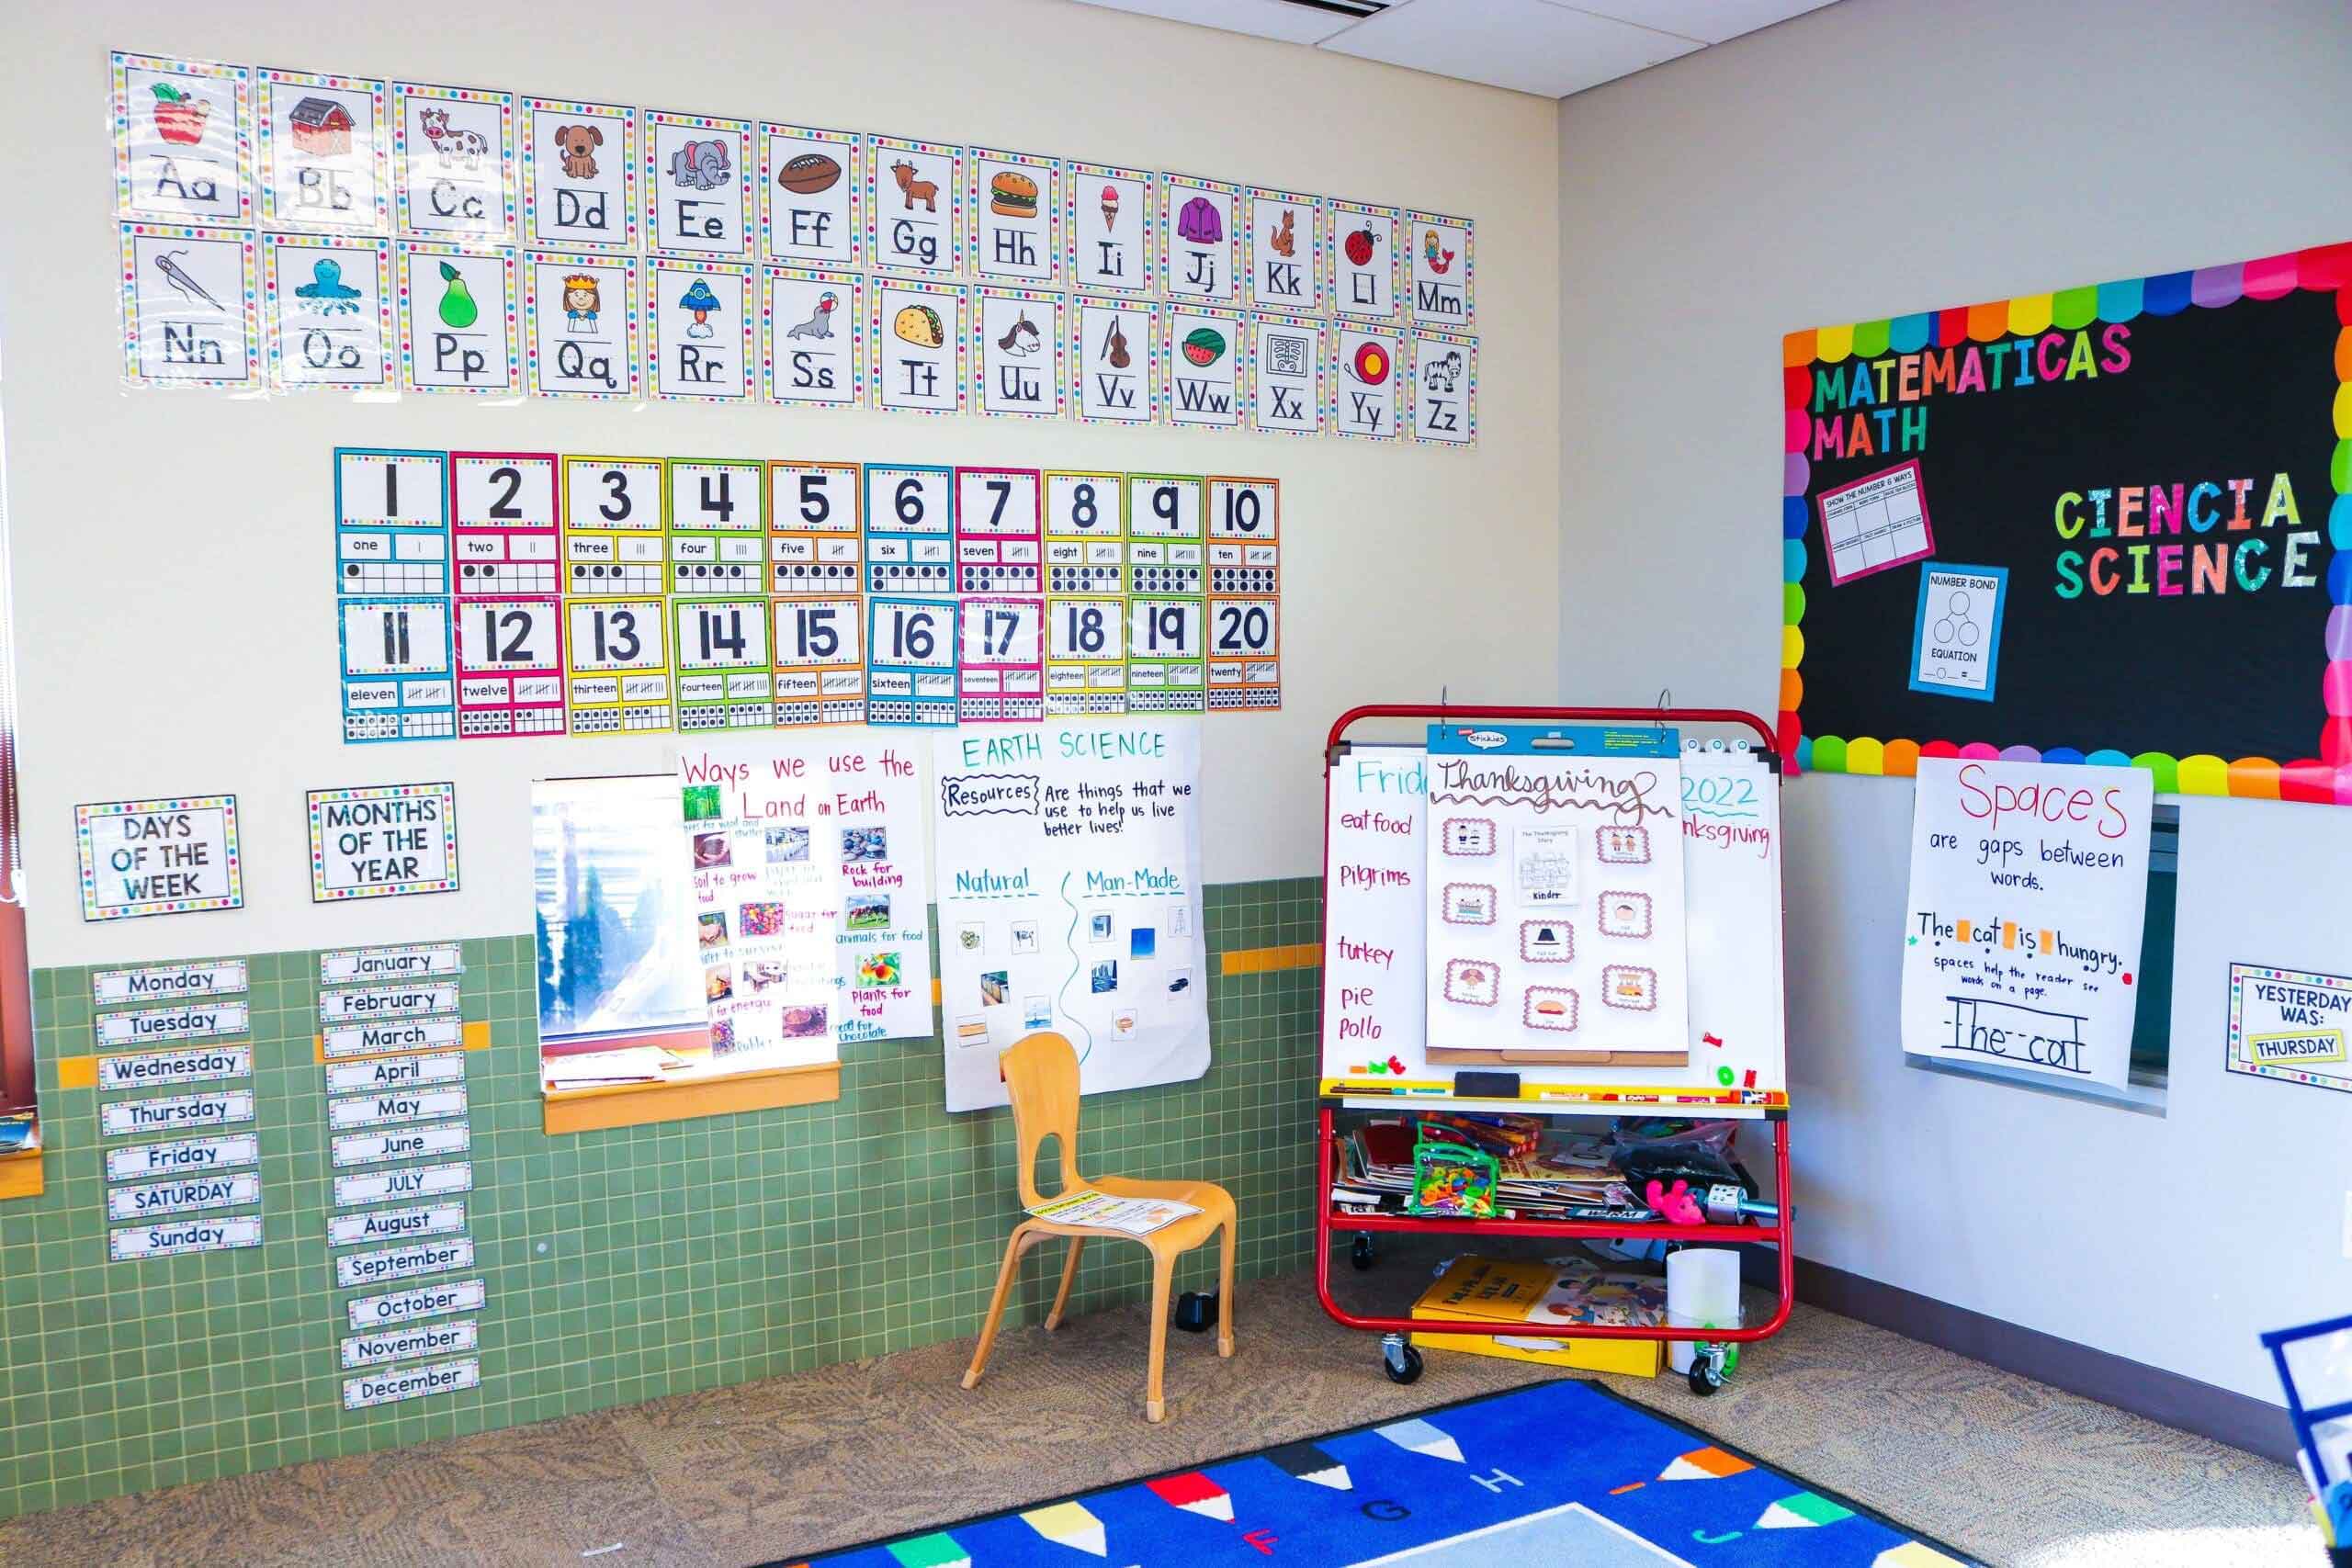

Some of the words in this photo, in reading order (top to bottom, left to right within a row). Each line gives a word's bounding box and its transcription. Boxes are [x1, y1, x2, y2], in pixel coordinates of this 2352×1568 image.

[556, 188, 606, 230] Dd
[678, 200, 723, 238] Ee
[792, 209, 831, 246] Ff
[894, 220, 936, 265] Gg
[995, 230, 1035, 265] Hh
[1267, 262, 1301, 295] Kk
[1419, 281, 1461, 314] Mm
[435, 333, 485, 382] Pp
[558, 342, 617, 389] Qq
[680, 345, 723, 382] Rr
[793, 352, 834, 389] Ss
[1815, 324, 2132, 412] MATEMATICAS
[902, 360, 938, 396] Tt
[1001, 366, 1040, 400] Uu
[1099, 375, 1134, 408] Vv
[1177, 378, 1229, 413] Ww
[1271, 386, 1303, 419] Xx
[1351, 392, 1381, 431] Yy
[1428, 400, 1456, 432] Zz
[1813, 406, 1928, 461] MATH
[489, 468, 522, 518] 2
[599, 470, 631, 521] 3
[701, 473, 734, 522] 4
[800, 475, 830, 523] 5
[895, 479, 923, 525] 6
[987, 481, 1011, 525] 7
[1826, 498, 1844, 508] SHOW
[1846, 491, 1857, 501] THE
[1858, 480, 1885, 496] NUMBER
[1894, 470, 1912, 483] WAYS
[1071, 483, 1097, 528] 8
[1152, 486, 1178, 529] 9
[1226, 489, 1260, 532] 10
[2054, 472, 2301, 539] CIENCIA
[353, 540, 378, 550] one
[468, 542, 493, 552] two
[573, 542, 608, 553] three
[681, 543, 707, 553] four
[781, 543, 805, 553] five
[881, 545, 895, 555] six
[963, 547, 994, 556] seven
[1053, 547, 1078, 558] eight
[1137, 548, 1156, 558] nine
[1218, 550, 1233, 559] ten
[2054, 531, 2322, 599] SCIENCE
[1930, 576, 1967, 588] NUMBER
[1970, 580, 1996, 590] BOND
[485, 610, 533, 661] 12
[594, 611, 640, 661] 13
[699, 610, 745, 660] 14
[797, 609, 838, 657] 15
[894, 611, 934, 659] 16
[1069, 607, 1104, 652] 18
[1148, 606, 1184, 650] 19
[1218, 606, 1268, 649] 20
[1931, 648, 1977, 662] EQUATION
[777, 678, 816, 689] fifteen
[872, 678, 910, 689] sixteen
[1211, 668, 1241, 678] twenty
[351, 688, 395, 700] eleven
[462, 684, 507, 696] twelve
[573, 683, 617, 694] thirteen
[963, 731, 1043, 768] EARTH
[1059, 731, 1166, 759] SCIENCE
[682, 753, 749, 792] Ways
[773, 757, 806, 778] we
[829, 752, 866, 773] use
[879, 749, 915, 778] the
[743, 791, 806, 819] Land
[818, 802, 831, 816] on
[837, 789, 886, 816] Earth
[947, 784, 1031, 807] Resources
[1045, 784, 1069, 802] Are
[1077, 782, 1123, 804] things
[1132, 780, 1165, 797] that
[1172, 783, 1192, 795] we
[1437, 759, 1657, 829] Thanksgiving
[1680, 777, 1758, 807] 2022
[1958, 764, 2128, 839] Spaces
[123, 815, 192, 840] DAYS
[326, 799, 436, 829] MONTHS
[1046, 806, 1067, 818] use
[1079, 805, 1092, 817] to
[1098, 802, 1125, 823] help
[1131, 805, 1145, 817] us
[1152, 802, 1175, 817] live
[338, 832, 371, 856] OF
[382, 828, 428, 851] THE
[1044, 821, 1082, 837] better
[1089, 819, 1124, 833] lives!
[111, 849, 145, 872] OF
[159, 842, 209, 868] THE
[1929, 831, 1958, 850] are
[1977, 837, 2024, 867] gaps
[2040, 840, 2124, 868] between
[351, 857, 420, 883] YEAR
[842, 864, 867, 875] Rock
[873, 863, 893, 874] for
[853, 874, 903, 887] building
[956, 867, 1030, 893] Natural
[1085, 867, 1181, 892] Man-Made
[1990, 871, 2044, 892] words.
[123, 874, 201, 900] WEEK
[1338, 935, 1394, 970] turkey
[1917, 911, 1953, 940] The
[1973, 916, 2002, 945] cat
[2019, 928, 2037, 950] is
[2057, 931, 2123, 974] hungry.
[352, 953, 432, 975] January
[1933, 956, 1974, 971] spaces
[1984, 962, 2004, 982] help
[2008, 966, 2025, 979] the
[2036, 973, 2074, 986] reader
[2083, 982, 2098, 993] see
[129, 971, 213, 994] Monday
[1961, 976, 1984, 986] words
[2025, 987, 2047, 999] page.
[343, 990, 435, 1012] February
[1341, 987, 1374, 1010] pie
[2256, 984, 2352, 1012] YESTERDAY
[130, 1012, 218, 1036] Tuesday
[2280, 1005, 2324, 1026] WAS:
[362, 1027, 426, 1048] March
[2029, 1017, 2086, 1071] cat
[2256, 1038, 2335, 1057] THURSDAY
[114, 1053, 237, 1078] Wednesday
[373, 1062, 420, 1084] April
[130, 1100, 227, 1124] Thursday
[377, 1099, 420, 1117] May
[148, 1145, 218, 1169] Friday
[380, 1135, 424, 1155] June
[134, 1181, 234, 1210] SATURDAY
[384, 1173, 424, 1193] JULY
[149, 1225, 224, 1249] Sunday
[364, 1213, 430, 1235] August
[352, 1247, 459, 1277] September
[377, 1292, 458, 1317] October
[357, 1330, 460, 1359] November
[361, 1370, 462, 1400] December
[1469, 1468, 1524, 1494] H
[1360, 1499, 1411, 1522] G
